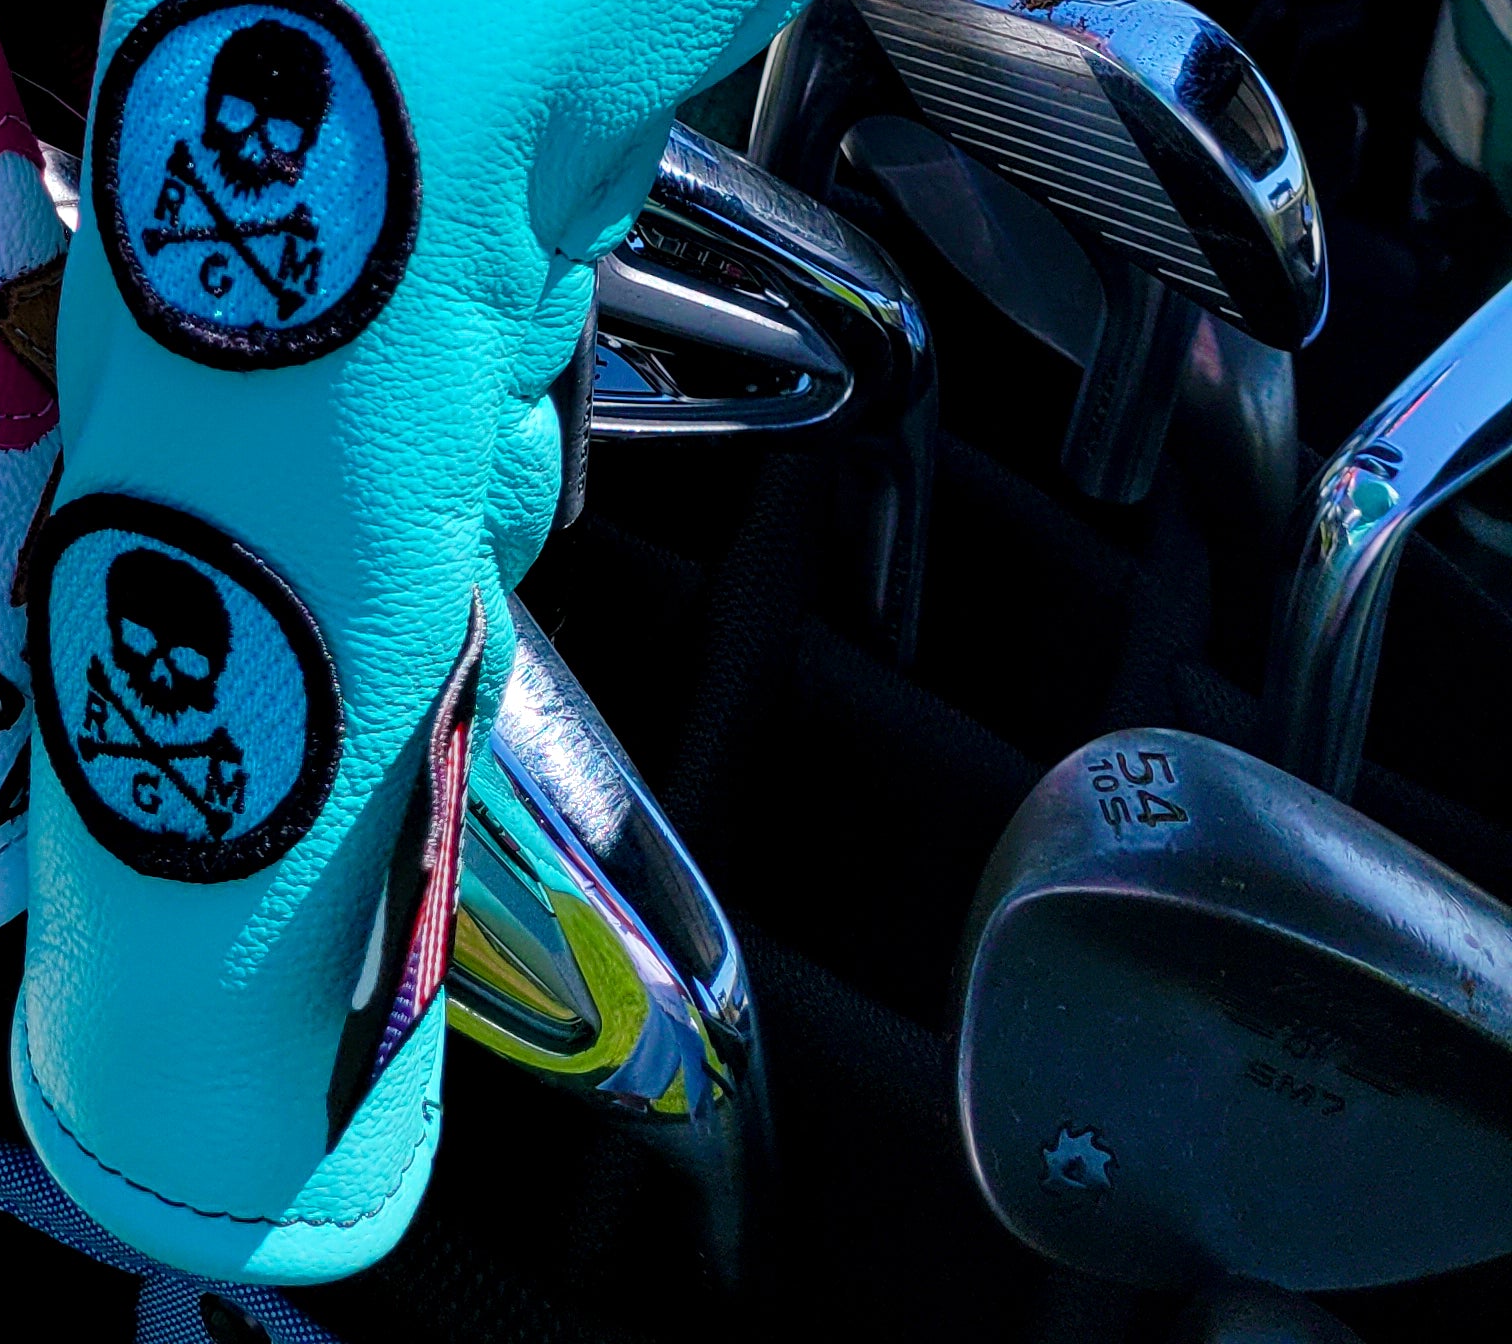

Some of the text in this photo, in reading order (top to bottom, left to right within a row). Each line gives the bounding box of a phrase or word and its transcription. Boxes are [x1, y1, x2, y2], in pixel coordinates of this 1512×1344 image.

[153, 177, 324, 299] R G M
[82, 691, 250, 815] R G M
[1116, 751, 1190, 828] 54
